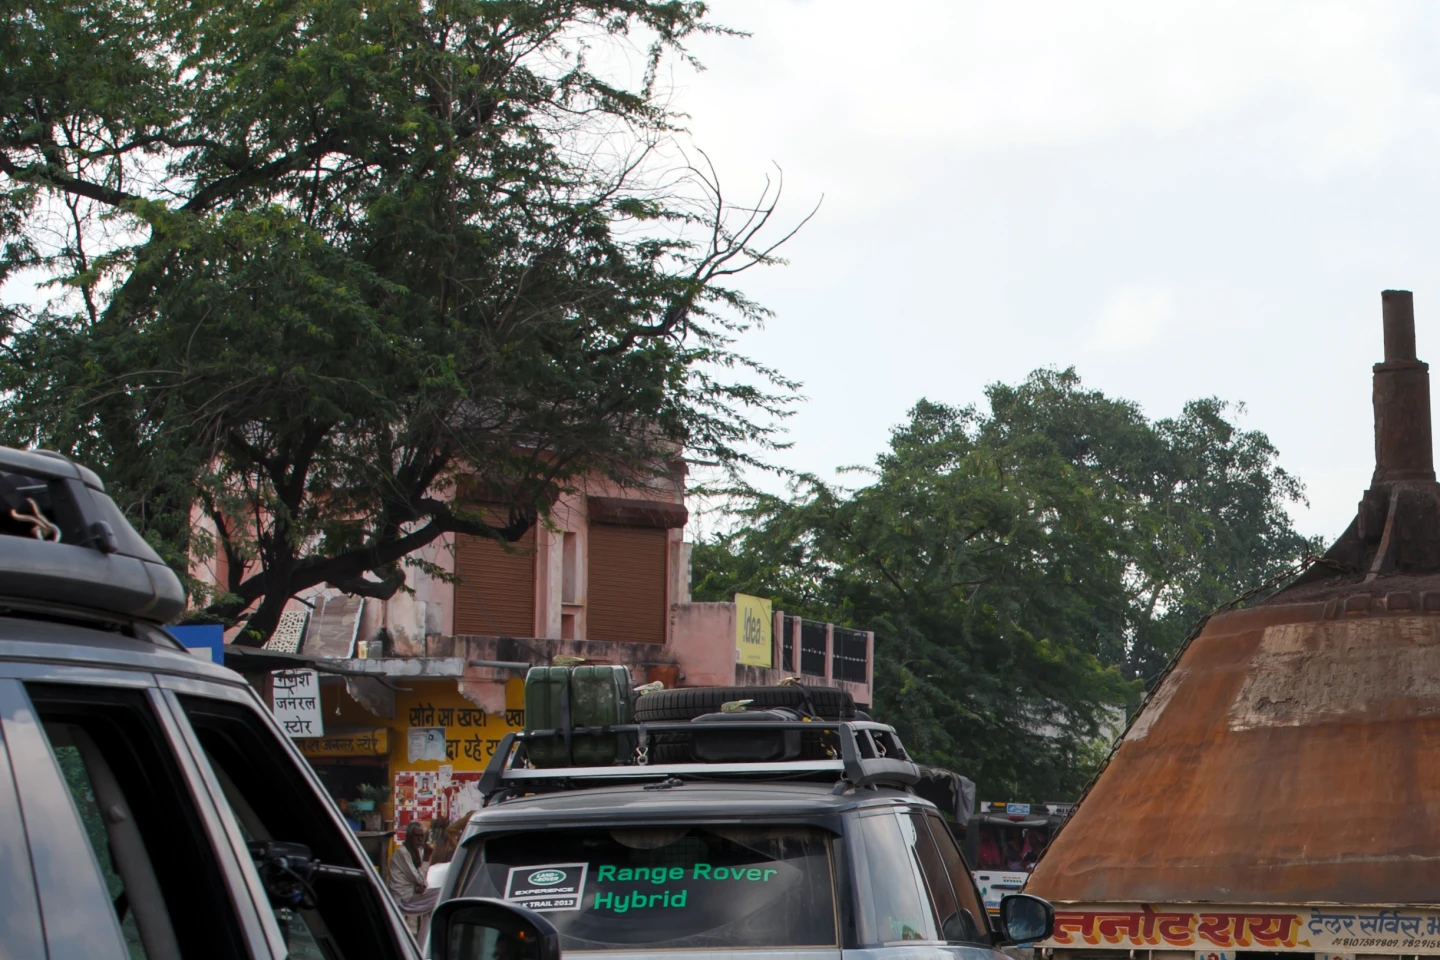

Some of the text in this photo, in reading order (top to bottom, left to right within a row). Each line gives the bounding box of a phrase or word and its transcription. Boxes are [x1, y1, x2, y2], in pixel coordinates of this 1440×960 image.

[275, 697, 316, 711] जनरल
[409, 702, 435, 727] सोने
[438, 708, 454, 727] सा
[283, 716, 312, 734] स्टोर
[464, 734, 483, 762] रहे
[597, 863, 777, 885] Range Rover
[515, 887, 575, 896] EXPERIENCE
[593, 889, 688, 913] Hybrid
[1198, 911, 1304, 948] राय
